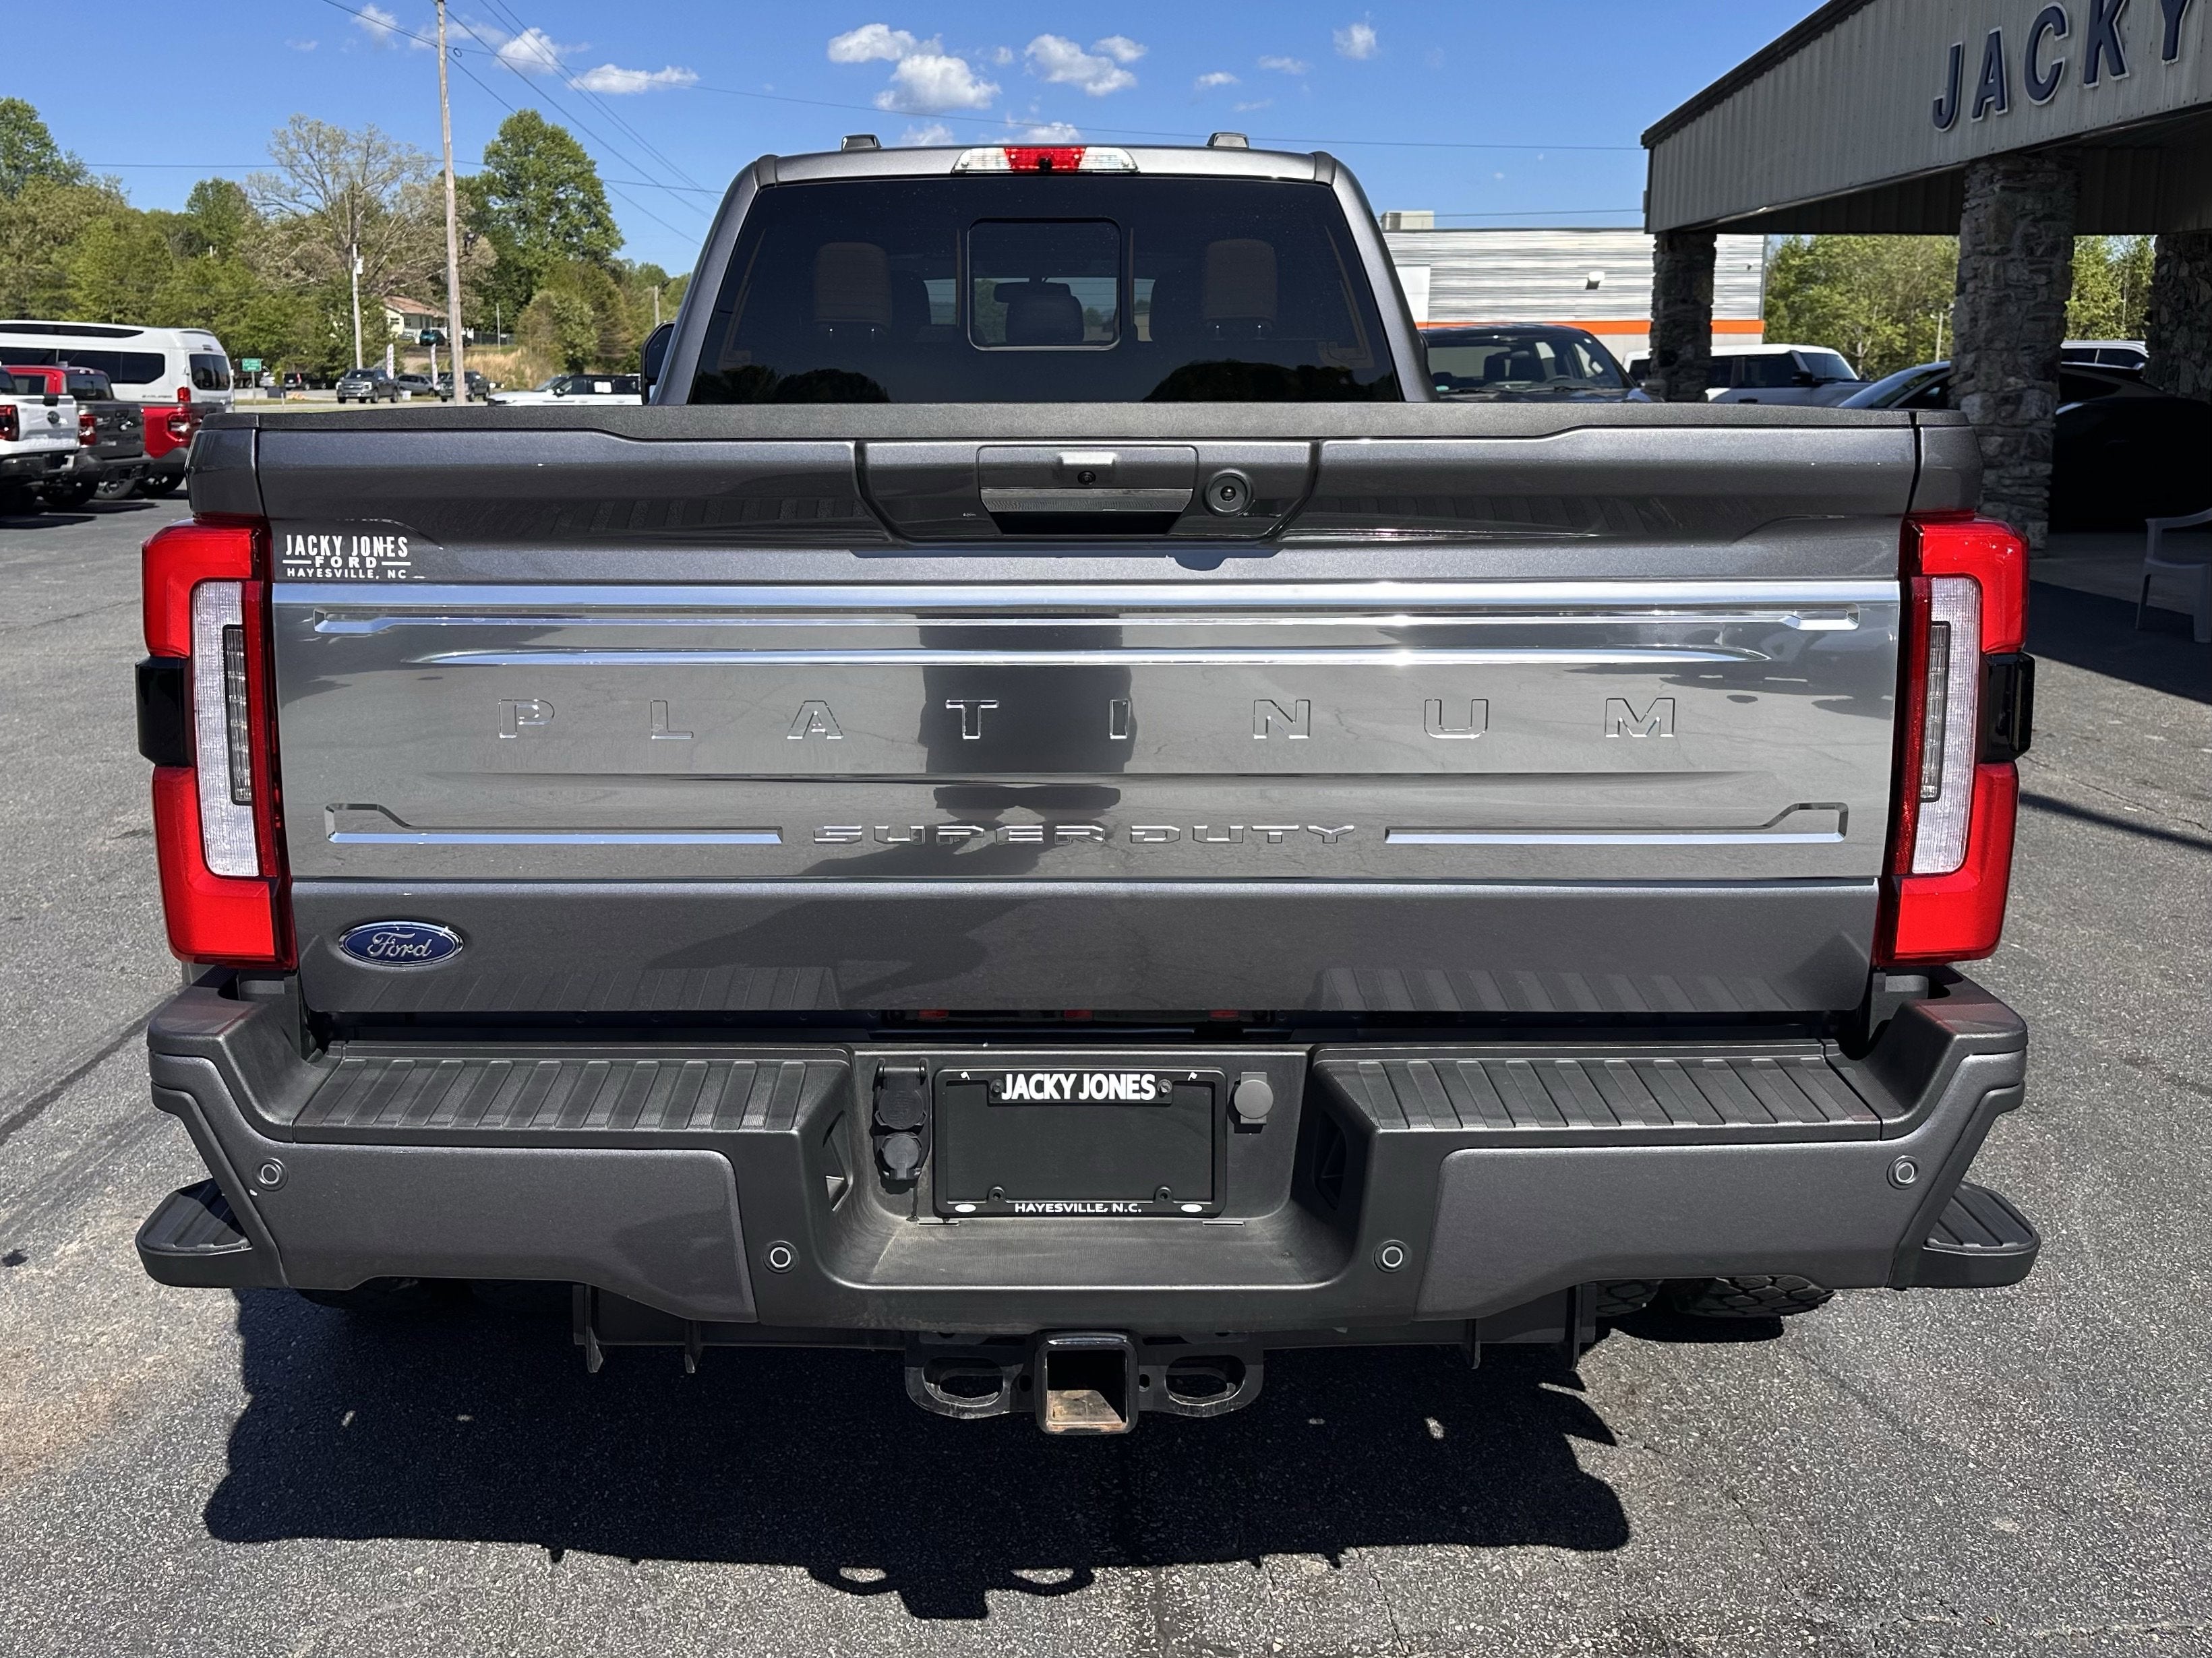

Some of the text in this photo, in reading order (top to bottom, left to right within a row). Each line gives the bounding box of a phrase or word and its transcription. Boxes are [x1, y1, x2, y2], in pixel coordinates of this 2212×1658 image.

[1932, 0, 2191, 133] JACKY
[286, 534, 408, 557] JACKY JONES
[287, 567, 407, 580] HAYESVILLE, NC
[315, 556, 377, 568] FORD
[498, 698, 1676, 739] PLATINUM
[813, 825, 1355, 845] SUPER DUTY
[367, 931, 433, 958] Ford
[1001, 1073, 1156, 1100] JACKY JONES
[1015, 1203, 1142, 1212] HAYESVILLE, N.C.
